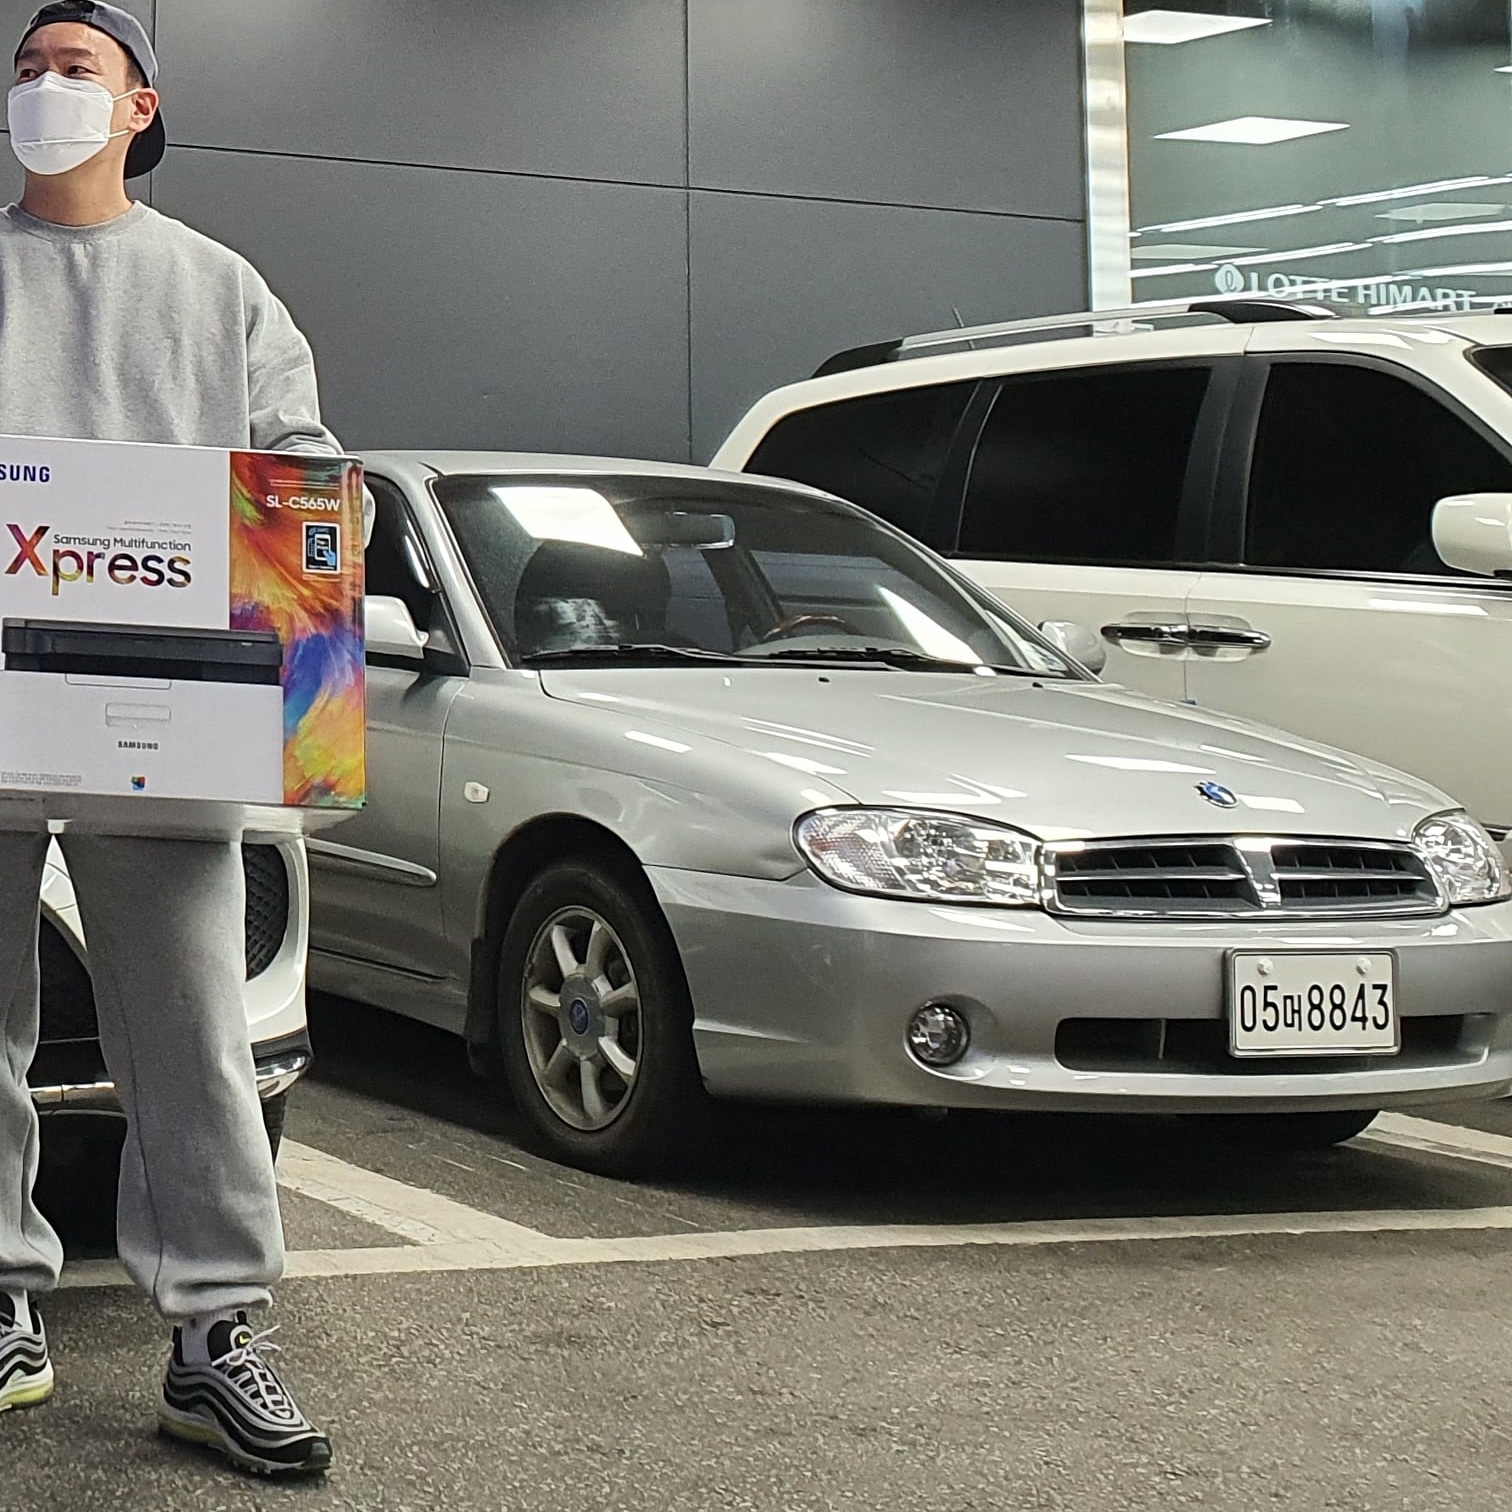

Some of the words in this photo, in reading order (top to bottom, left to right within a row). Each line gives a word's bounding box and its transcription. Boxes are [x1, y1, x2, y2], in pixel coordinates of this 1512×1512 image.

[1250, 272, 1351, 303] LOTTE
[1357, 283, 1478, 312] HIMART
[266, 494, 340, 512] SL-C565W
[4, 523, 192, 596] Xpress
[53, 533, 111, 550] Samsung
[113, 537, 192, 552] Multifunction
[1240, 982, 1389, 1032] 05머8843
